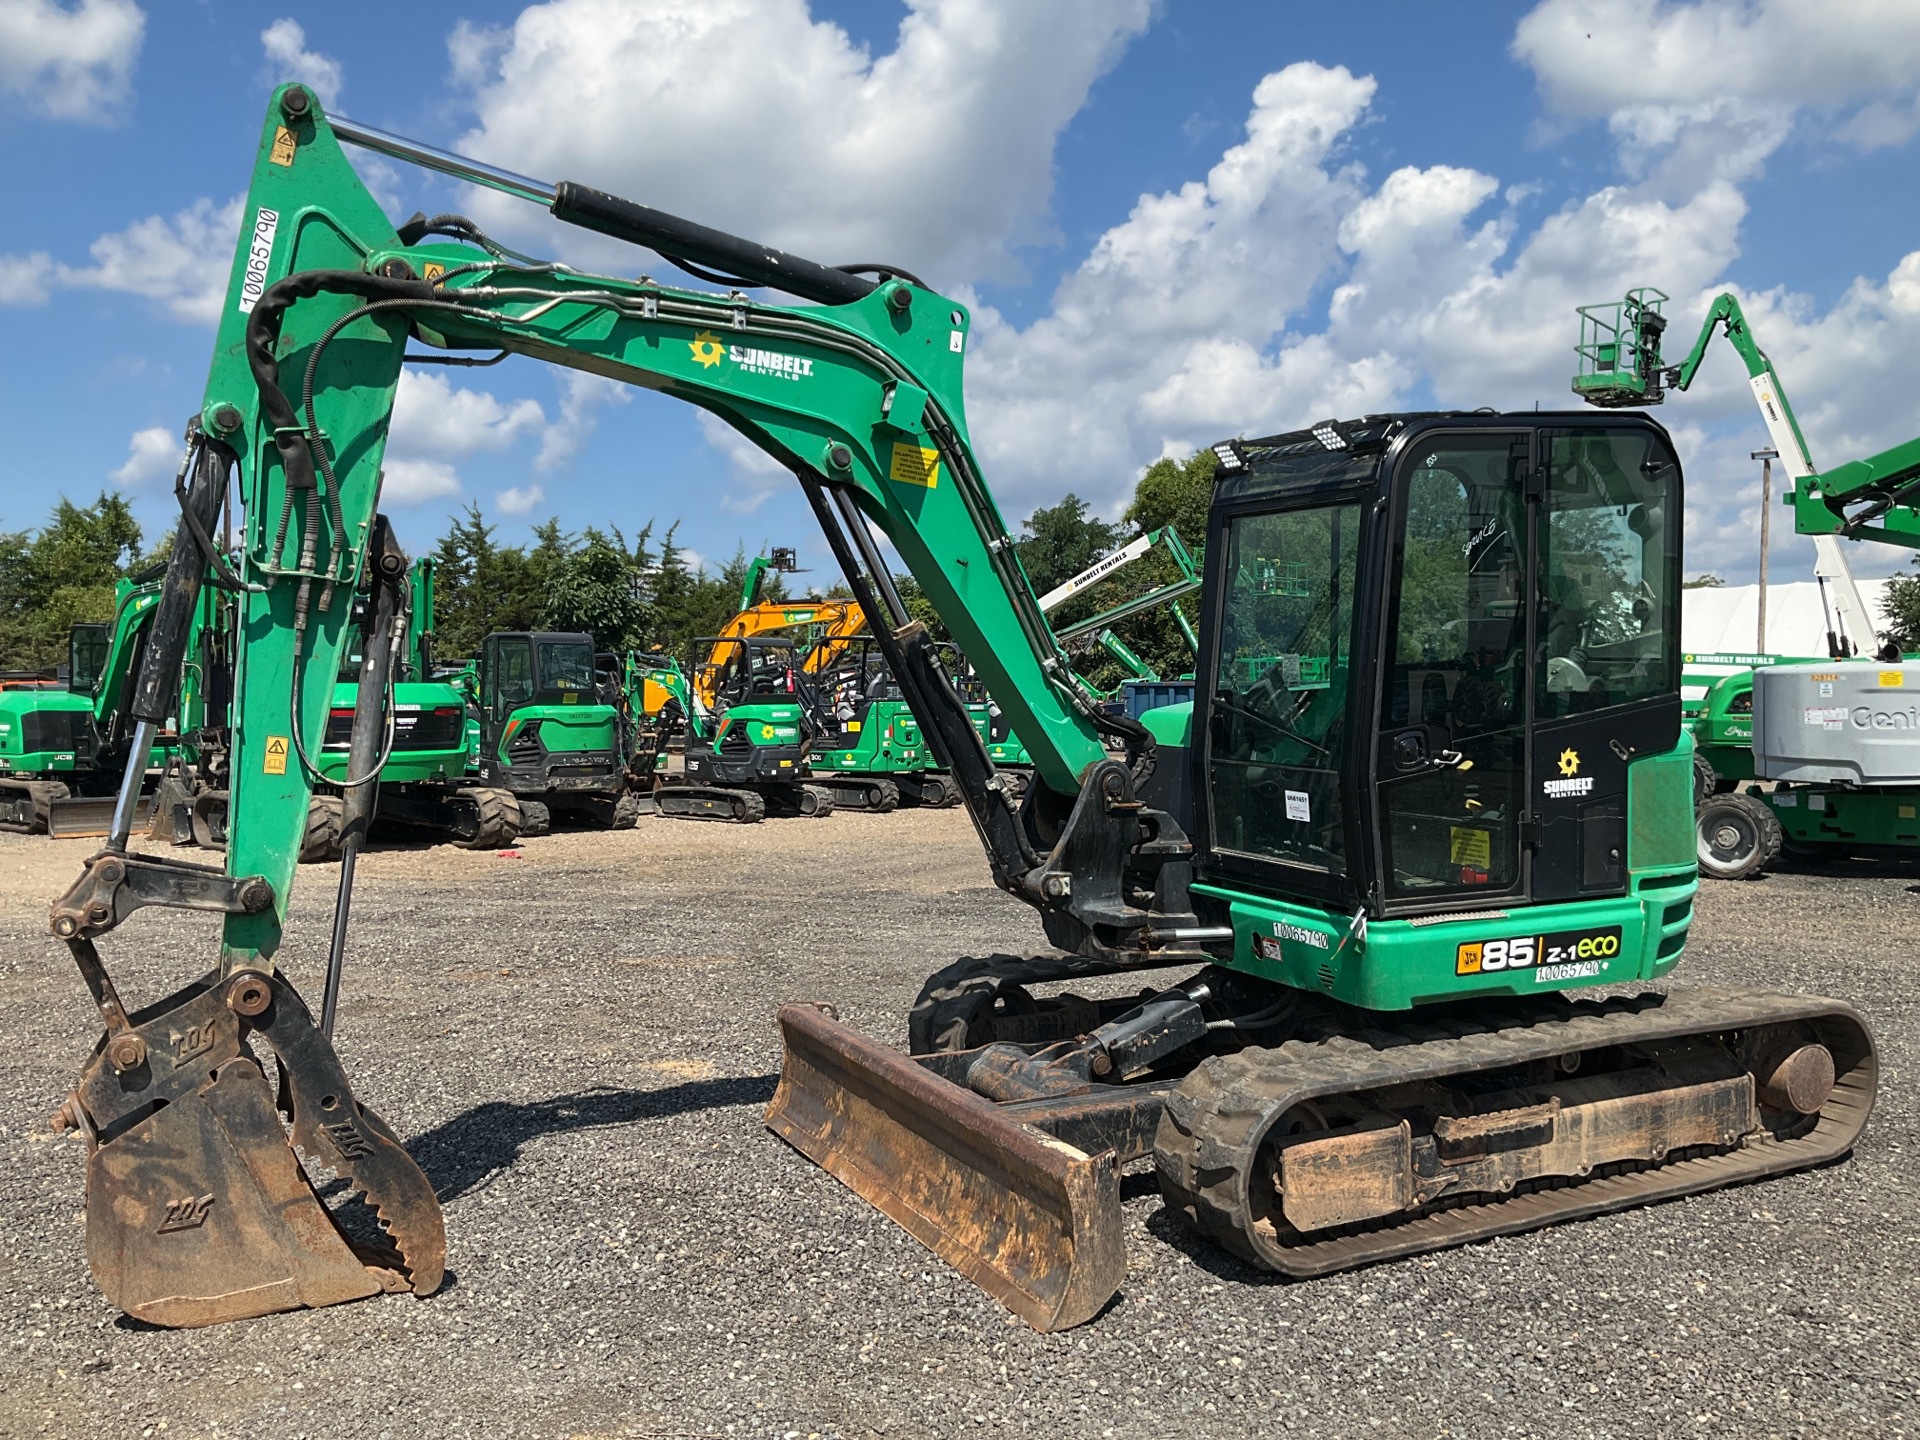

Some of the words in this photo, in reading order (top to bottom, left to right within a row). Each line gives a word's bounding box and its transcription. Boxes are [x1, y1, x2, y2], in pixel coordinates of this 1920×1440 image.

[242, 209, 277, 305] 10065790
[729, 345, 813, 376] SUNBELT
[740, 363, 800, 381] RENTALS
[1074, 569, 1100, 587] SUNBELT
[1100, 552, 1127, 572] RENTALS
[1695, 655, 1734, 664] SUNBELT
[1735, 656, 1775, 665] RENTALS
[1850, 706, 1920, 731] Geni
[1543, 777, 1594, 794] SUNBELT
[1550, 790, 1587, 799] RENTALS
[1274, 922, 1328, 948] 10065790
[1481, 937, 1535, 971] 85
[1538, 961, 1600, 982] 10065790
